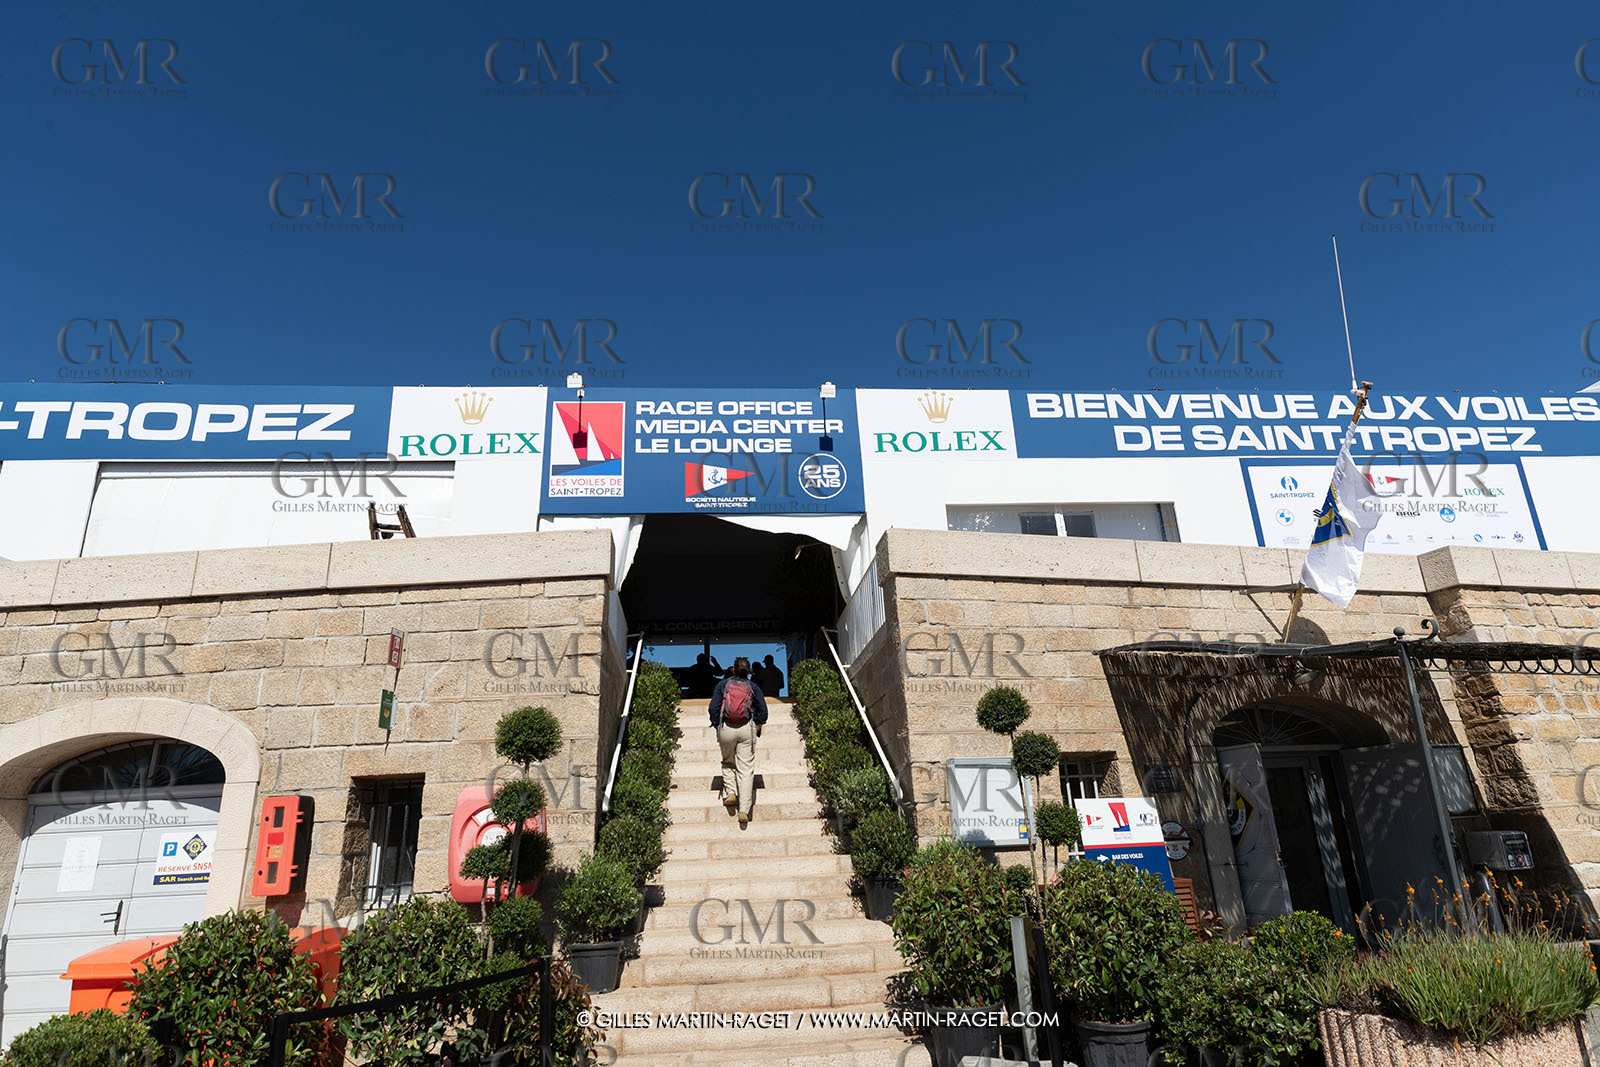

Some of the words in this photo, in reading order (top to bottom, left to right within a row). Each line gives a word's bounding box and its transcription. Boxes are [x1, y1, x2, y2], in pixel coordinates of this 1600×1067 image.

[636, 400, 713, 415] RACE
[718, 400, 813, 415] OFFICE
[1026, 393, 1319, 419] BIENVENUE
[1327, 394, 1435, 420] AUX
[1435, 396, 1600, 422] VOILES
[636, 419, 728, 434] MEDIA
[733, 419, 844, 434] CENTER
[399, 432, 541, 457] ROLEX
[635, 438, 669, 453] LE
[675, 438, 792, 453] LOUNGE
[873, 430, 1007, 453] ROLEX
[1113, 425, 1185, 451] DE
[1191, 425, 1543, 452] SAINT-TROPEZ
[803, 464, 840, 479] 25
[550, 479, 566, 487] LES
[571, 478, 605, 487] VOILES
[609, 478, 622, 486] DE
[805, 478, 840, 488] ANS
[550, 487, 622, 496] SAINT-TROPEZ
[1463, 487, 1505, 496] ROLEX
